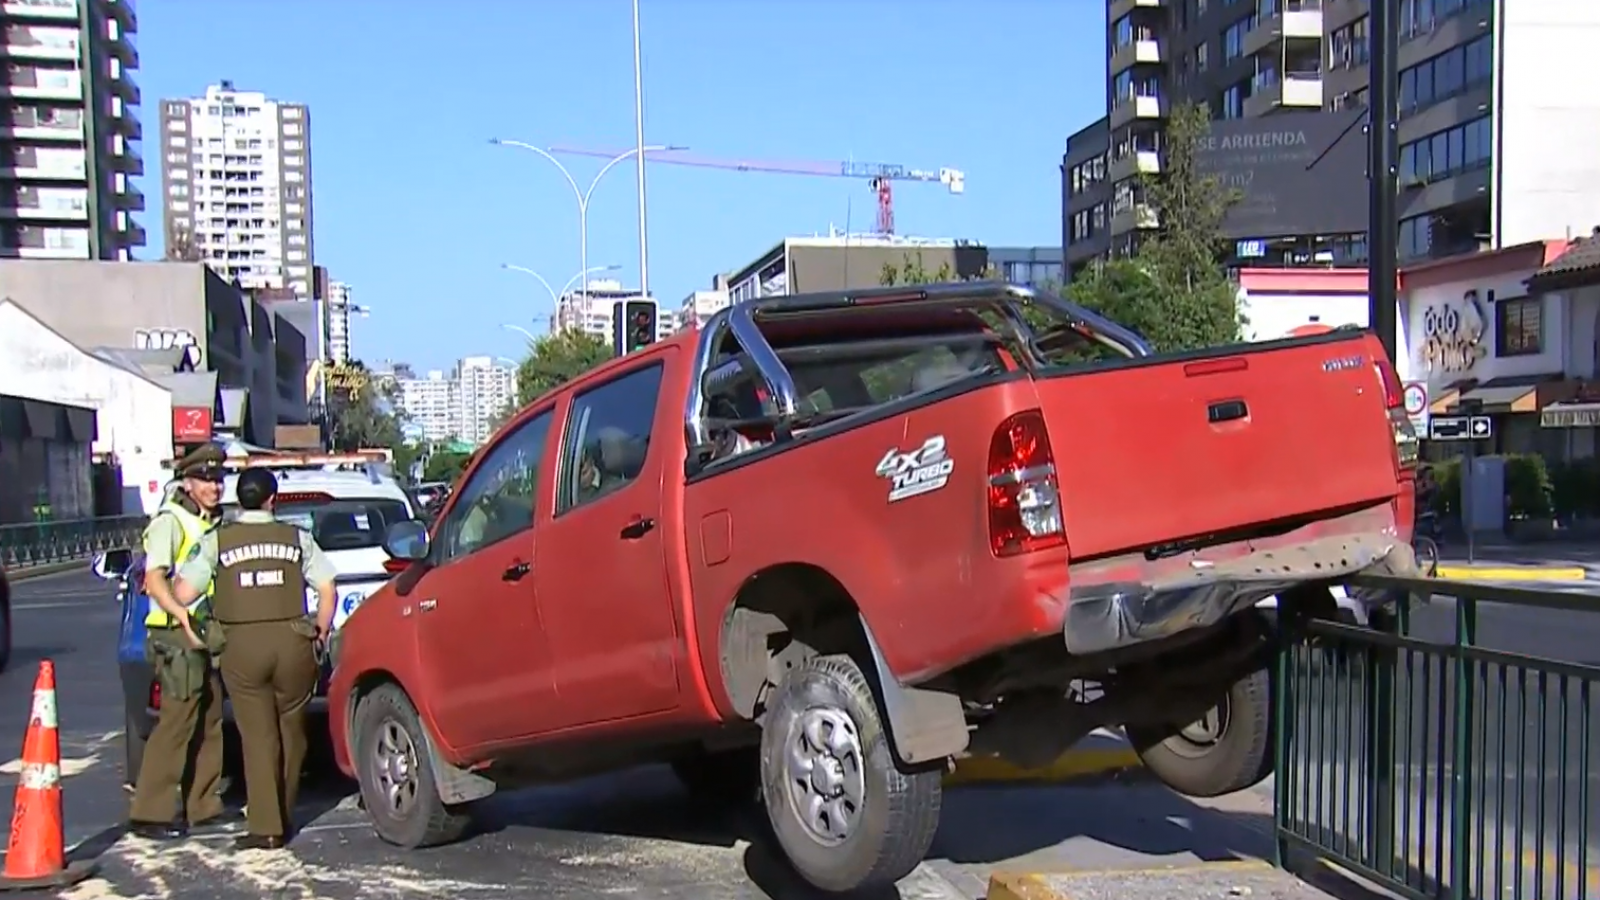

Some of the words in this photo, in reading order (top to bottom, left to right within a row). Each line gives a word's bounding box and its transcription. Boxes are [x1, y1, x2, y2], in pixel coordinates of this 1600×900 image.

[1198, 136, 1217, 150] SE
[1221, 130, 1307, 150] ARRIENDA
[892, 458, 954, 490] TURBO
[220, 543, 300, 568] CARABINEROS
[240, 571, 254, 587] DE
[256, 569, 284, 587] CHILE
